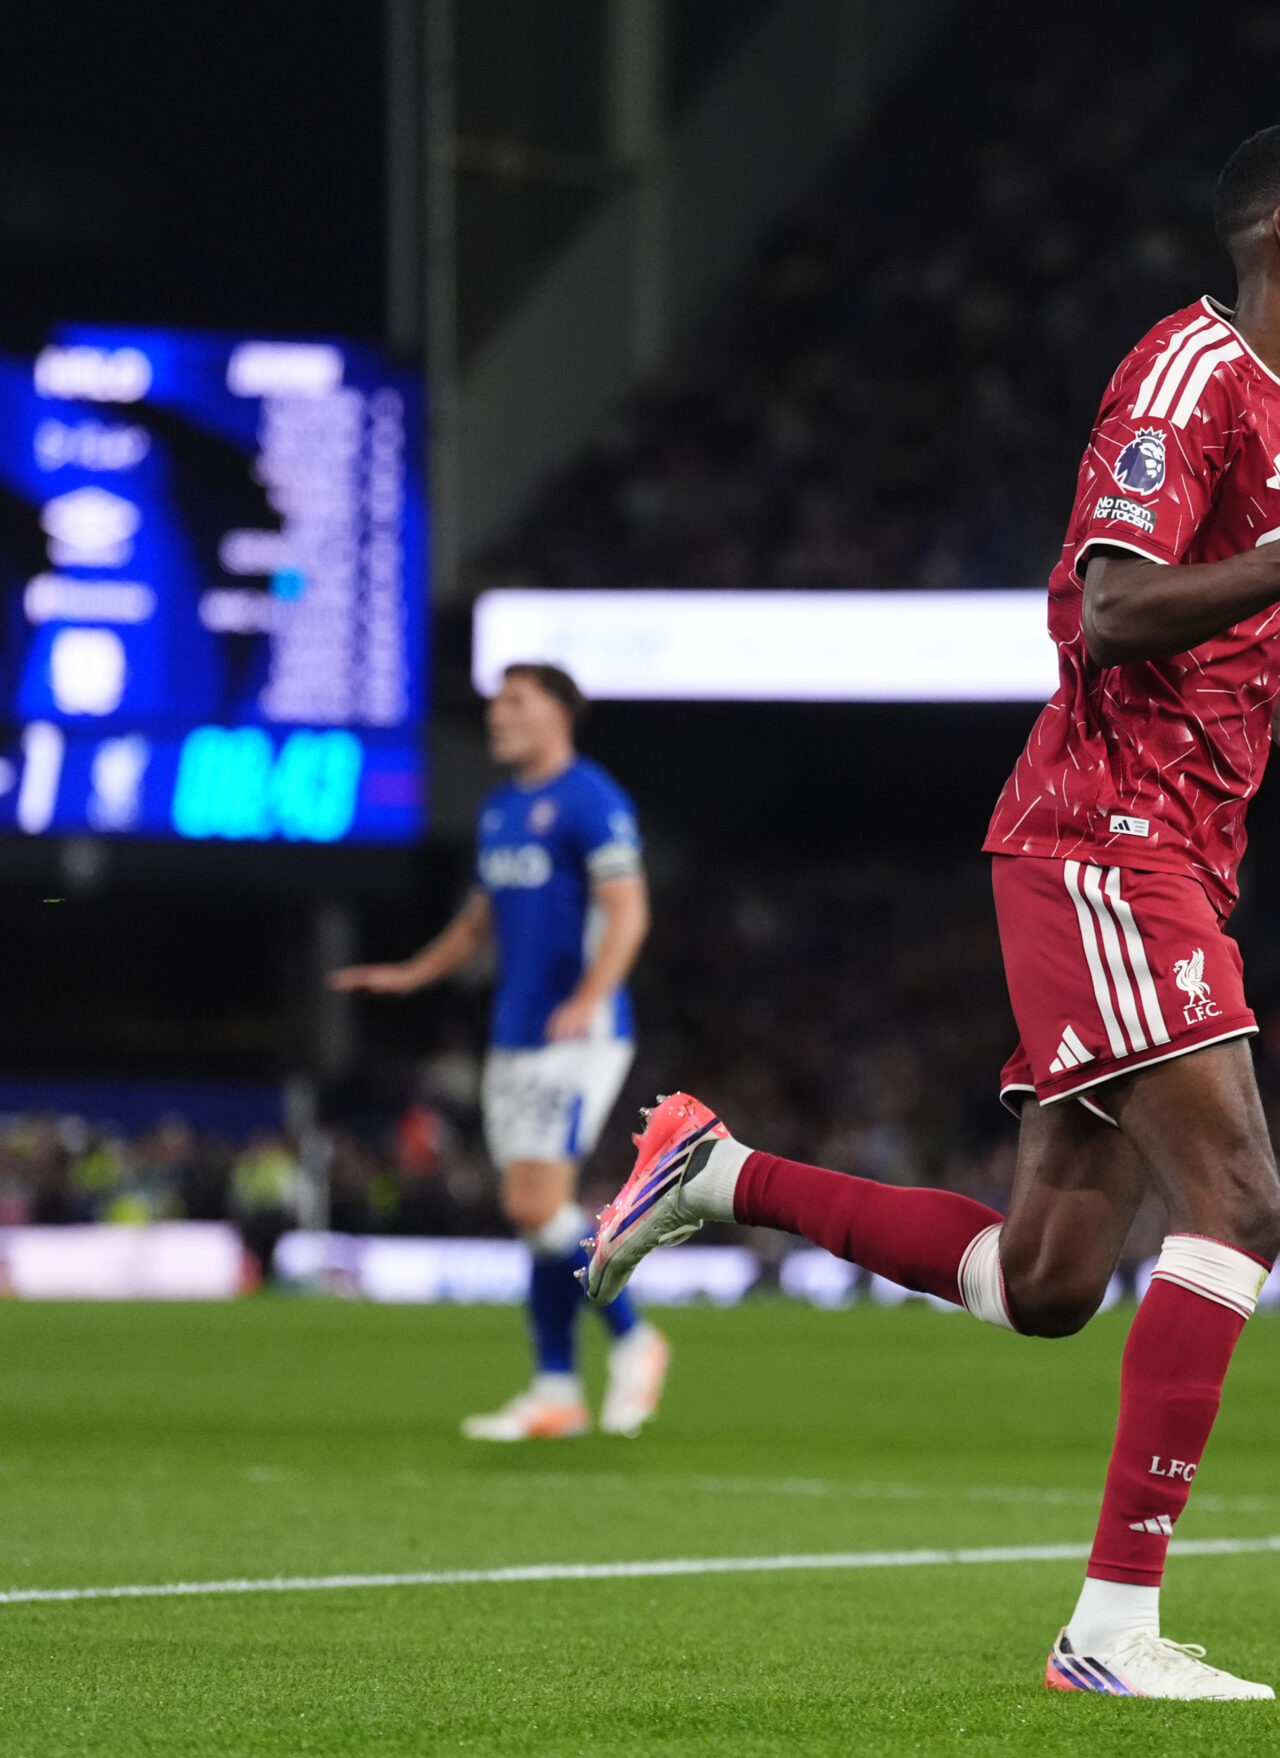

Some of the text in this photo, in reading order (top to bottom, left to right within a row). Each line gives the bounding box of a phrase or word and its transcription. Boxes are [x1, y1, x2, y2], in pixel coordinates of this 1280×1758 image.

[1093, 507, 1154, 534] for racism
[1097, 496, 1152, 521] No room
